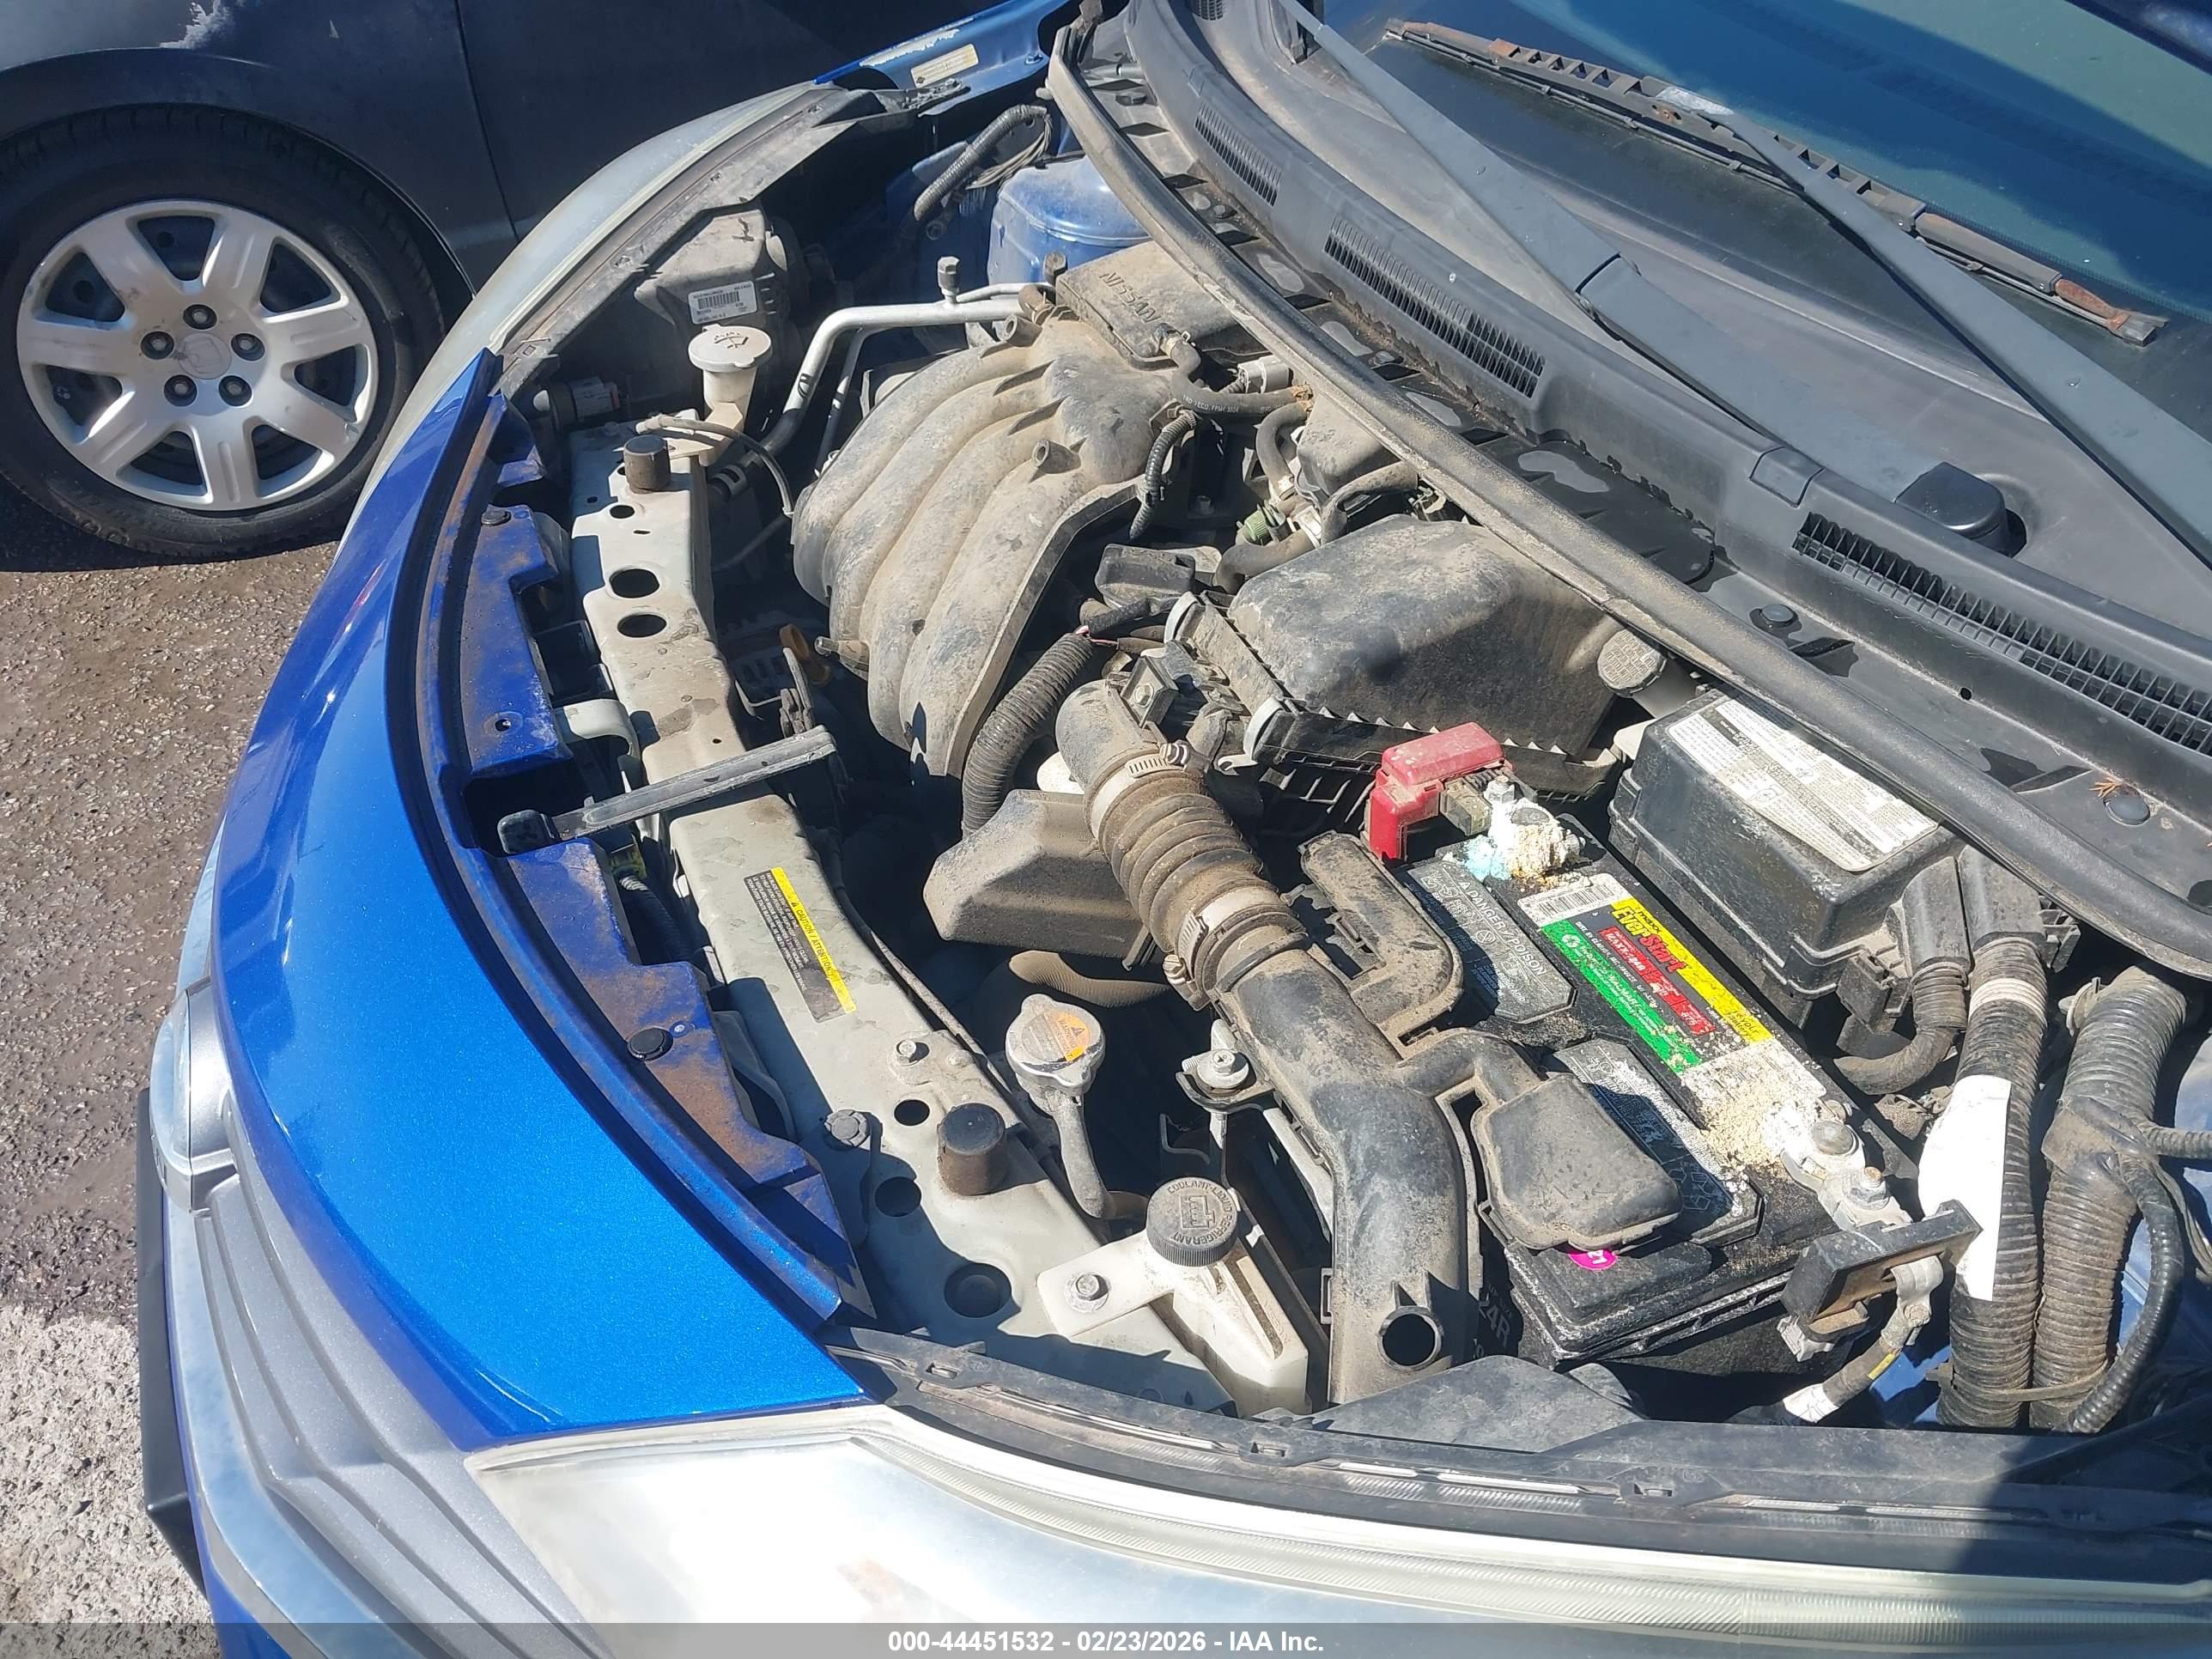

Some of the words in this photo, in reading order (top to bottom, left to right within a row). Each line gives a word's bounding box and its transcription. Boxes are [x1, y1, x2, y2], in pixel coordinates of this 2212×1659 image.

[1099, 271, 1162, 324] NISSAN
[795, 909, 812, 933] CAUTION
[811, 939, 833, 970] ATTENTION
[1468, 890, 1506, 931] DANGER
[1508, 937, 1548, 976] POISON
[1611, 906, 1686, 973] EverStart
